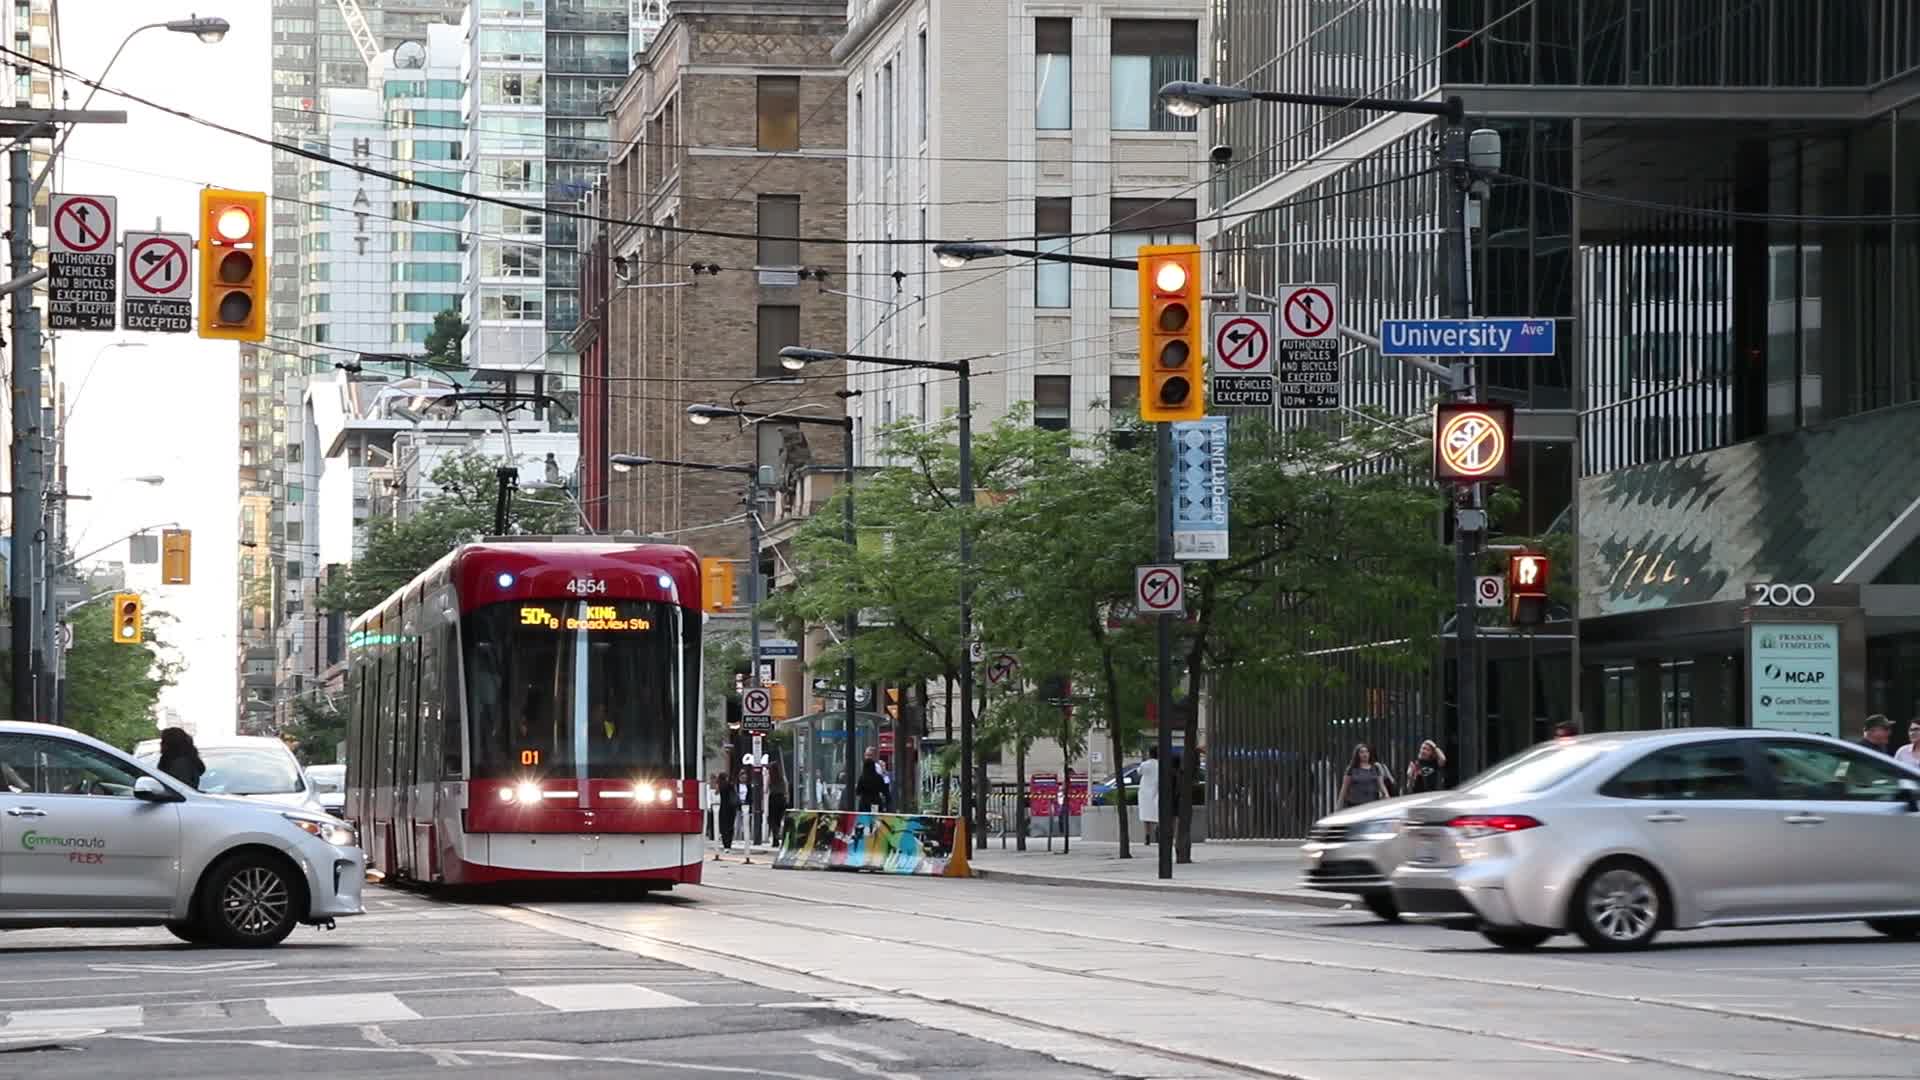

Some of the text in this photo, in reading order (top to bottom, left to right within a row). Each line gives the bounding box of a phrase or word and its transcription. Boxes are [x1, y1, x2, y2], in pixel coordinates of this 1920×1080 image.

[353, 137, 369, 256] HYATT
[51, 254, 114, 266] AUTHORIZED
[59, 265, 106, 277] VEHICLES
[50, 279, 115, 290] AND BICYCLES
[57, 290, 108, 301] EXCEPTED
[49, 303, 115, 316] TAXIS EXCEPTED
[126, 303, 191, 316] TTC VEHICLES
[128, 316, 188, 329] EXCEPTED
[1391, 323, 1545, 352] University Ave
[1282, 340, 1337, 350] AUTHORIZED
[1288, 350, 1331, 361] VEHICLES
[1282, 361, 1338, 372] AND BICYCLES
[1287, 372, 1332, 383] EXCEPTED
[1215, 380, 1272, 390] TTC VEHICLES
[1217, 391, 1270, 402] EXCEPTED
[1212, 422, 1225, 525] OPPORTUNITY
[566, 579, 607, 593] 4554
[1755, 583, 1815, 606] 200
[586, 606, 617, 620] KING
[566, 618, 628, 630] Broadview
[630, 618, 650, 630] Stn
[1779, 633, 1824, 641] FRANKLIN
[1785, 671, 1825, 683] MCAP
[521, 750, 539, 765] 01
[21, 830, 105, 850] Communauto
[69, 853, 105, 864] FLEX
